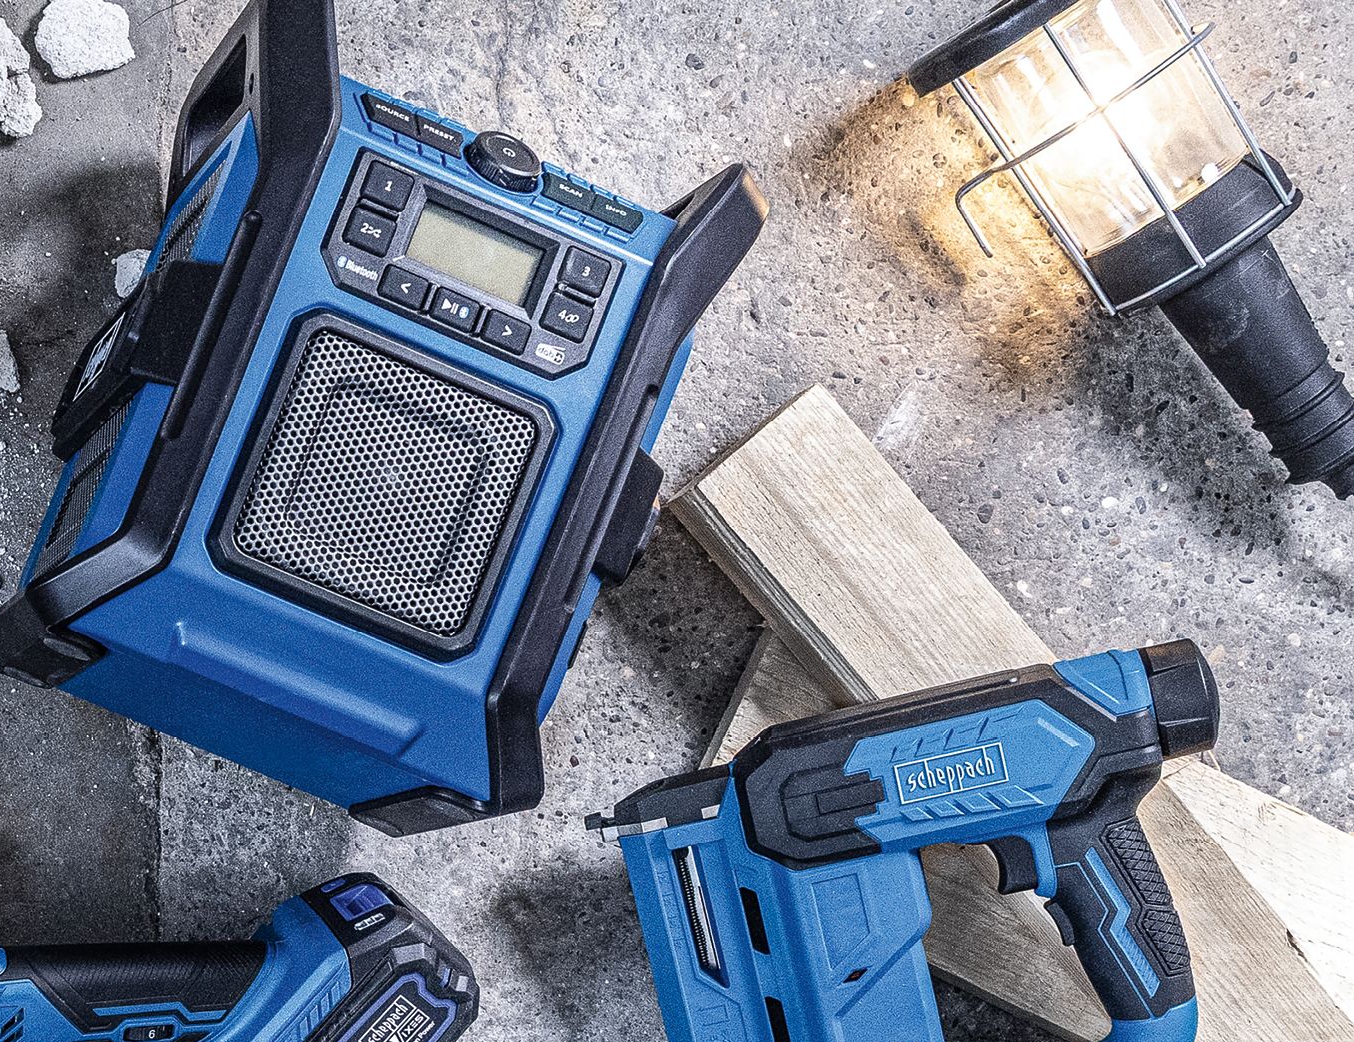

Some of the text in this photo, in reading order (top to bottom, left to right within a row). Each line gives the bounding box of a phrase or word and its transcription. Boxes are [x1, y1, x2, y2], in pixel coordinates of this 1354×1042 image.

[375, 103, 410, 122] SOURCE
[423, 124, 454, 141] PRESET
[384, 180, 393, 192] 1
[559, 183, 583, 198] SCAN
[345, 259, 378, 280] Bluetooth
[581, 265, 591, 277] 3
[907, 747, 995, 793] scheppach
[148, 1029, 156, 1039] 6
